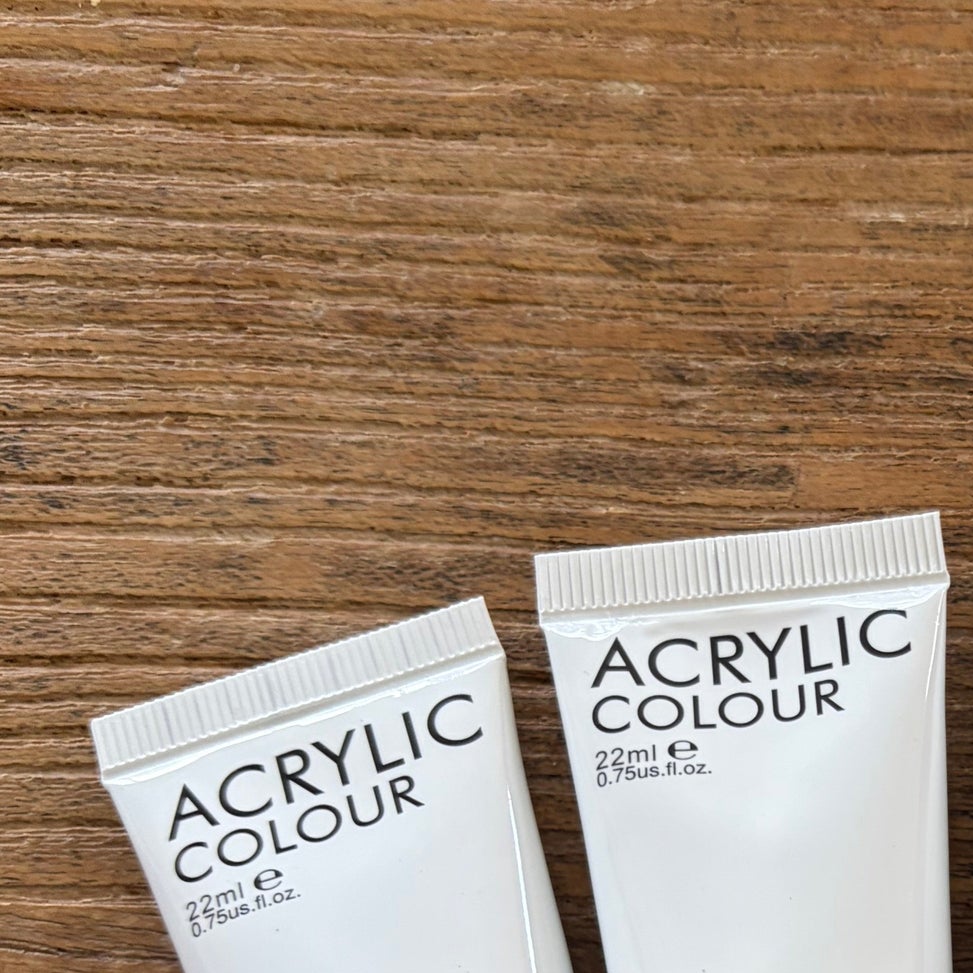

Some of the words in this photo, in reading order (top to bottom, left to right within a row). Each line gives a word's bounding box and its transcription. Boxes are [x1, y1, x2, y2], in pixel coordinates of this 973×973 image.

[591, 609, 911, 688] ACRYLIC
[592, 678, 845, 734] COLOUR
[168, 694, 483, 841] ACRYLIC
[595, 744, 656, 771] 22ml
[596, 761, 712, 788] 0.75us.fl.oz.
[174, 775, 425, 882] COLOUR
[186, 882, 244, 922] 22ml
[192, 888, 301, 937] 0.75us.fl.oz.
